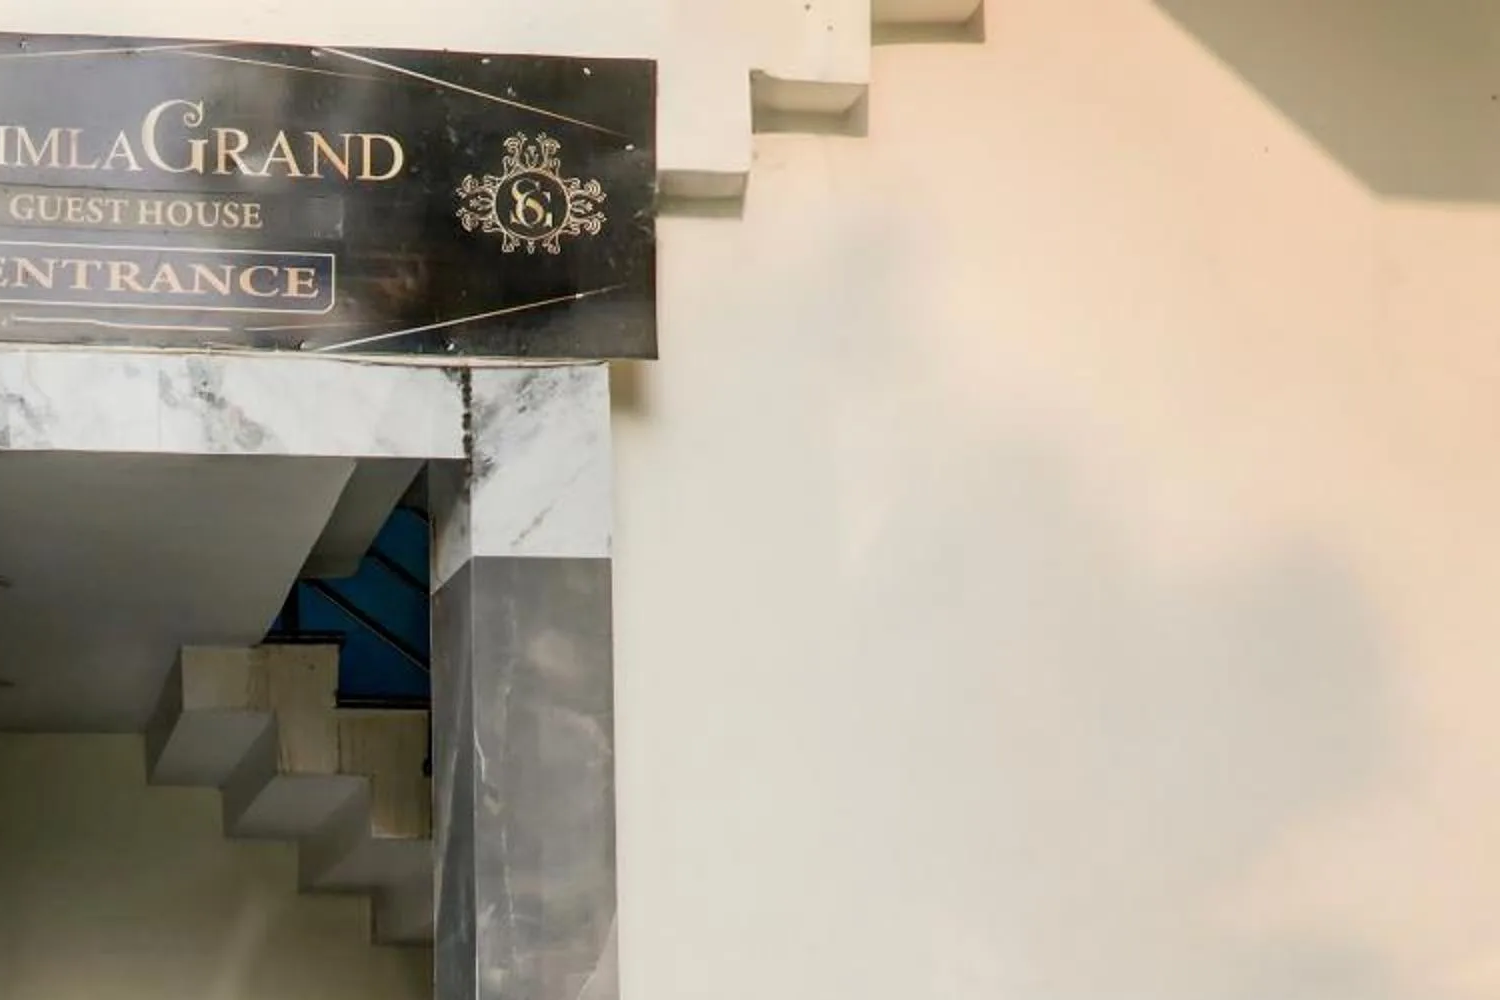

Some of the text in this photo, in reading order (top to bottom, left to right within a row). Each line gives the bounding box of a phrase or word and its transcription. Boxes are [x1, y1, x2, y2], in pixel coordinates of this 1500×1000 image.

[141, 98, 405, 182] GRAND
[9, 192, 264, 231] GUEST HOUSE
